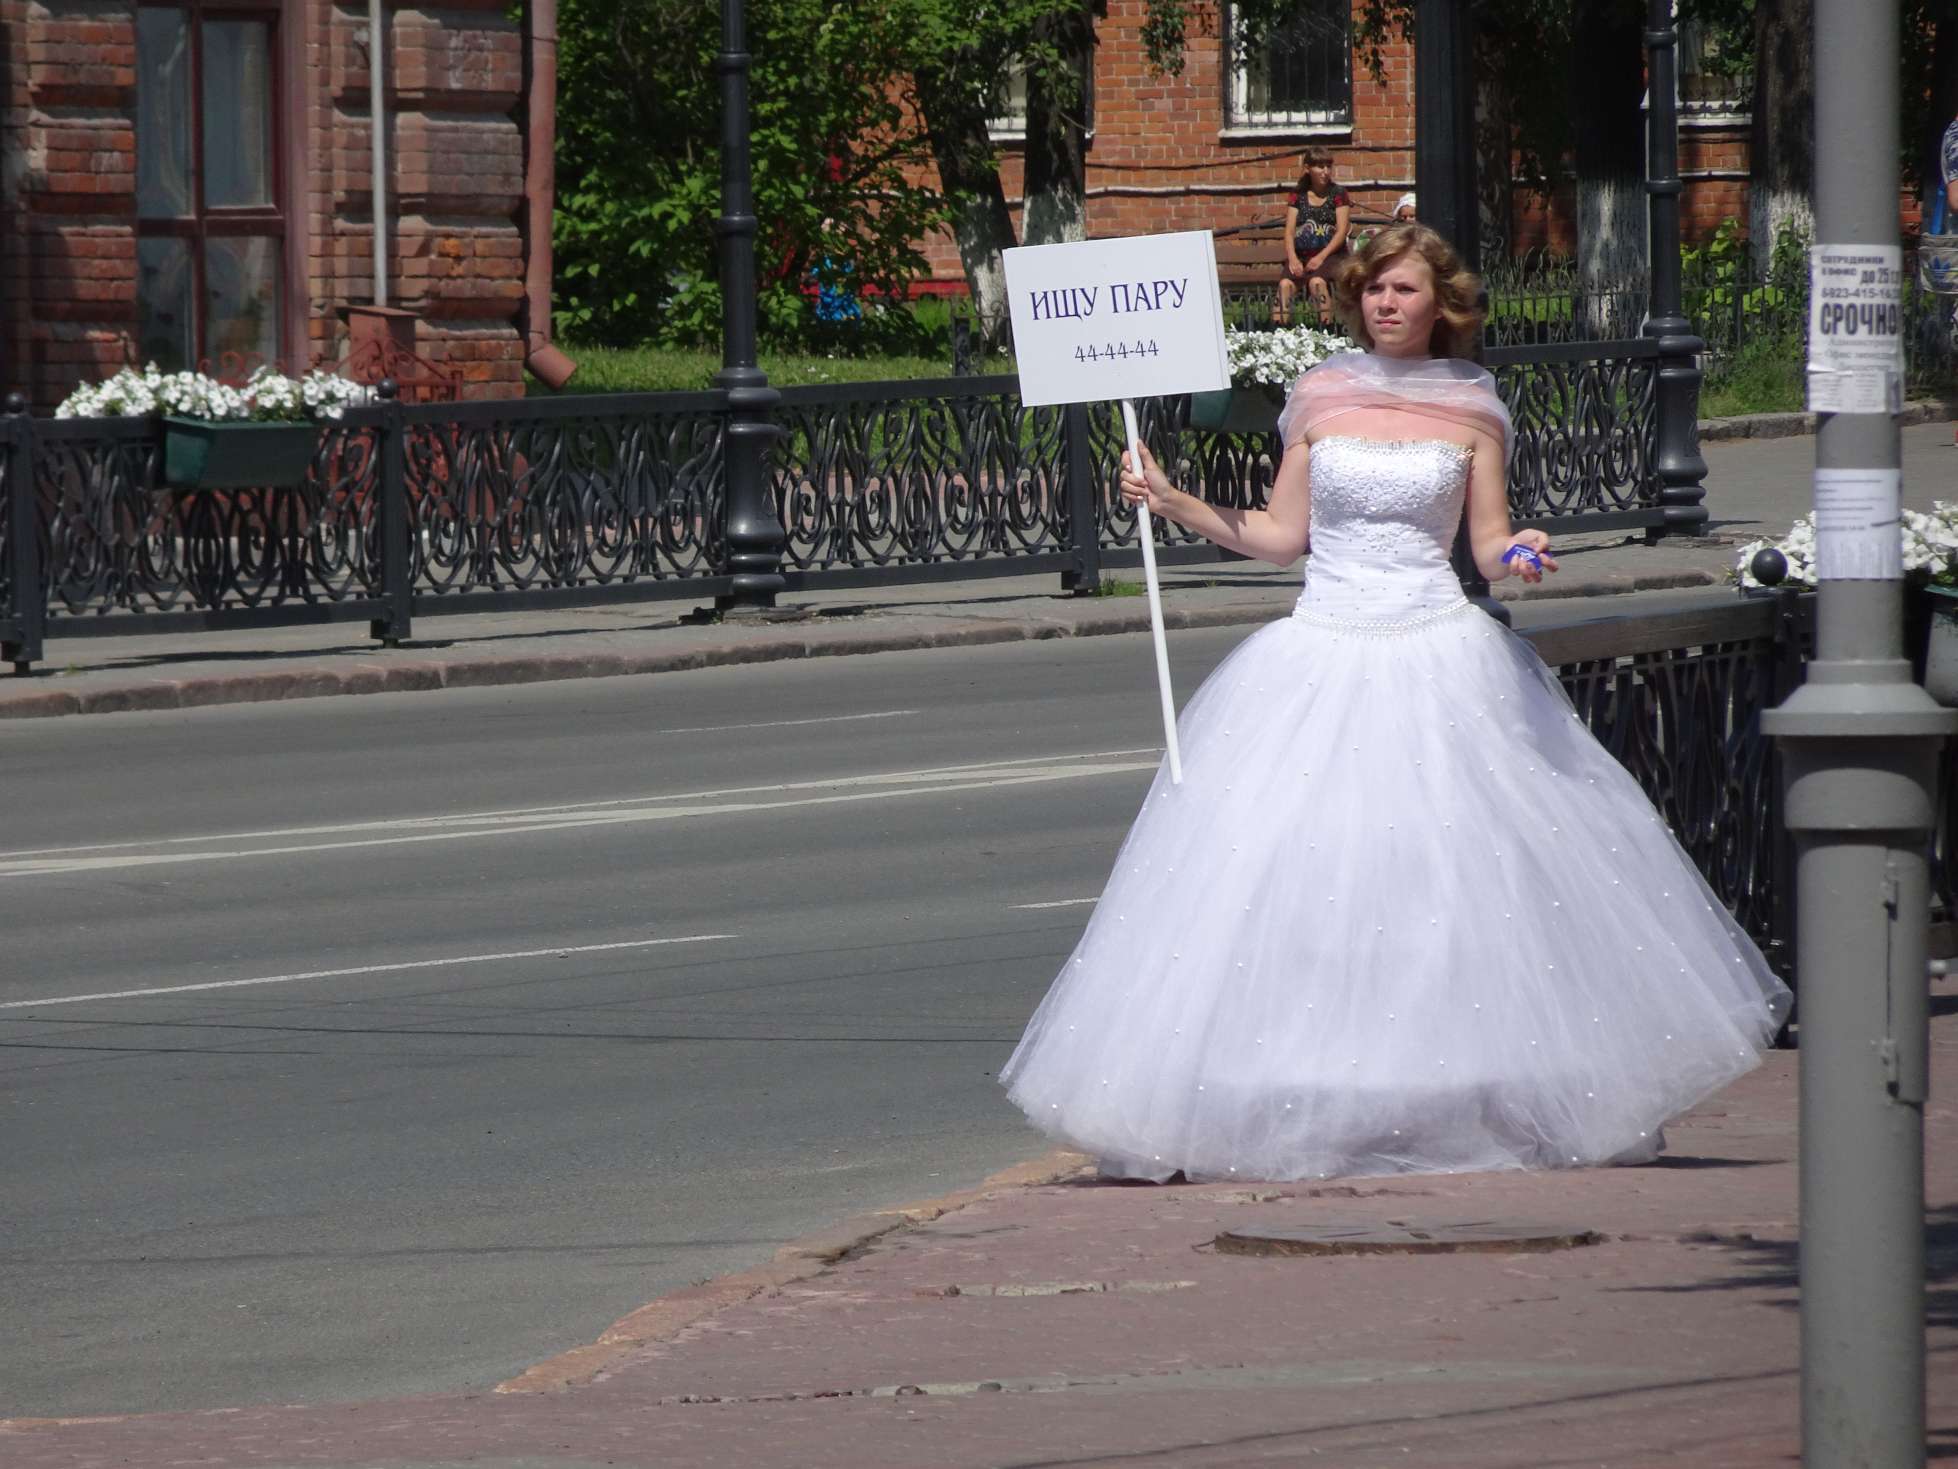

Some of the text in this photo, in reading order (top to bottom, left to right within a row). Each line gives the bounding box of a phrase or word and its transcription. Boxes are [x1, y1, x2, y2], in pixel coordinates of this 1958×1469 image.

[1029, 278, 1188, 322] ИЩУ ПАРУ
[1820, 303, 1898, 336] СРОЧНО
[1074, 338, 1160, 363] 44-44-44
